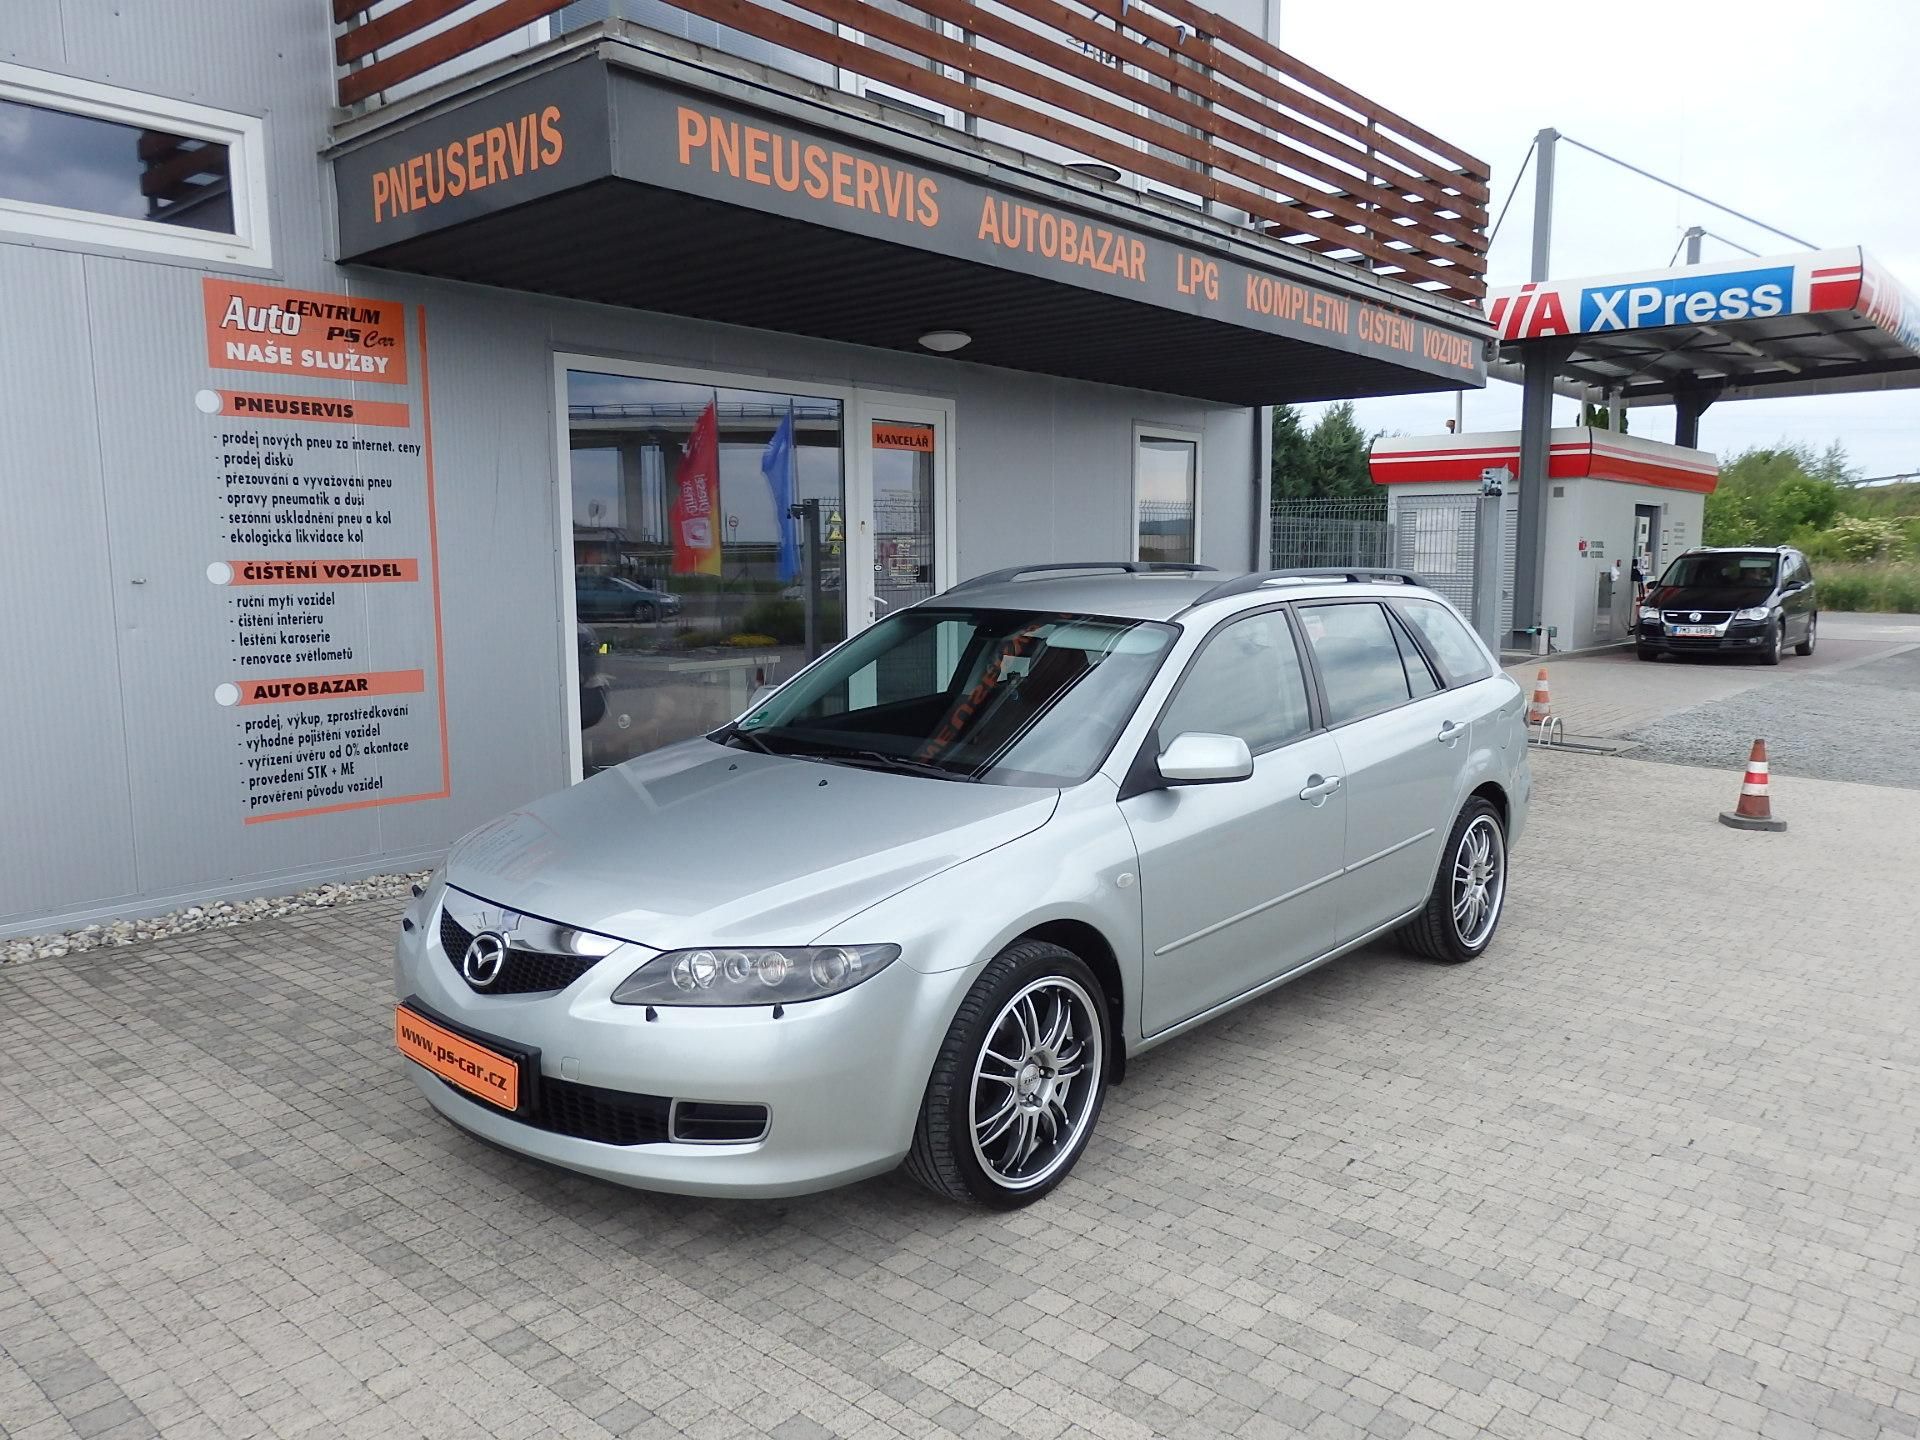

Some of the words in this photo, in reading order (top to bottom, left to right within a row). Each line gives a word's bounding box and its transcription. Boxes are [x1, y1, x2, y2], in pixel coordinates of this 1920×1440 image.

[372, 105, 563, 223] PNEUSERVIS
[676, 107, 938, 228] PNEUSERVIS
[978, 197, 1146, 283] AUTOBAZAR
[1176, 254, 1219, 301] LPG
[1246, 274, 1350, 335] KOMPLETNÍ
[1358, 299, 1417, 353] ČIŠTĚNÍ
[1423, 326, 1474, 370] VOZIDEL
[219, 295, 301, 336] Auto
[285, 299, 380, 325] CENTRUM
[1590, 283, 1782, 333] XPress
[326, 327, 361, 343] PS
[363, 330, 396, 347] Car
[226, 340, 293, 366] NAŠE
[301, 348, 389, 374] SLUŽBY
[234, 396, 354, 418] PNEUSERVIS
[222, 430, 259, 448] prodej
[262, 433, 302, 450] nových
[306, 438, 332, 450] pneu
[336, 440, 348, 450] za
[352, 436, 395, 452] internet.
[398, 443, 421, 456] ceny
[876, 433, 929, 448] KANCELÁŘ
[224, 450, 261, 469] prodej
[225, 472, 289, 487] přezouvání
[292, 476, 299, 485] a
[303, 475, 364, 489] vyvažování
[368, 478, 392, 490] pneu
[227, 494, 268, 508] opravy
[272, 491, 330, 508] pneumatik
[334, 496, 340, 505] a
[229, 511, 271, 524] sezónní
[274, 510, 334, 524] uskladnění
[337, 515, 362, 527] pneu
[366, 515, 372, 524] a
[375, 511, 392, 524] kol
[230, 529, 292, 546] ekologická
[295, 529, 344, 543] likvidace
[347, 529, 364, 542] kol
[243, 562, 317, 580] ČIŠTĚNÍ
[323, 563, 402, 579] VOZIDEL
[236, 594, 264, 608] ruční
[297, 592, 335, 606] vozidel
[238, 613, 274, 627] čištění
[277, 611, 324, 626] interiéru
[239, 631, 277, 646] leštění
[280, 629, 331, 644] karoserie
[240, 653, 292, 665] renovace
[295, 647, 353, 663] světlometů
[253, 678, 368, 700] AUTOBAZAR
[245, 714, 283, 733] prodej,
[287, 712, 323, 729] výkup,
[327, 704, 408, 725] zprostředkování
[246, 734, 294, 752] výhodné
[298, 728, 342, 747] pojištění
[345, 723, 381, 739] vozidel
[247, 752, 293, 771] vyřízení
[296, 750, 326, 763] úvěru
[329, 747, 342, 759] od
[345, 743, 360, 757] 0%
[363, 741, 409, 755] akontace
[249, 769, 304, 790] provedení
[307, 765, 328, 780] STK
[341, 762, 355, 775] ME
[250, 790, 303, 809] prověření
[306, 782, 344, 801] původu
[347, 776, 383, 792] vozidel
[401, 1025, 508, 1091] www.ps-car.cz
